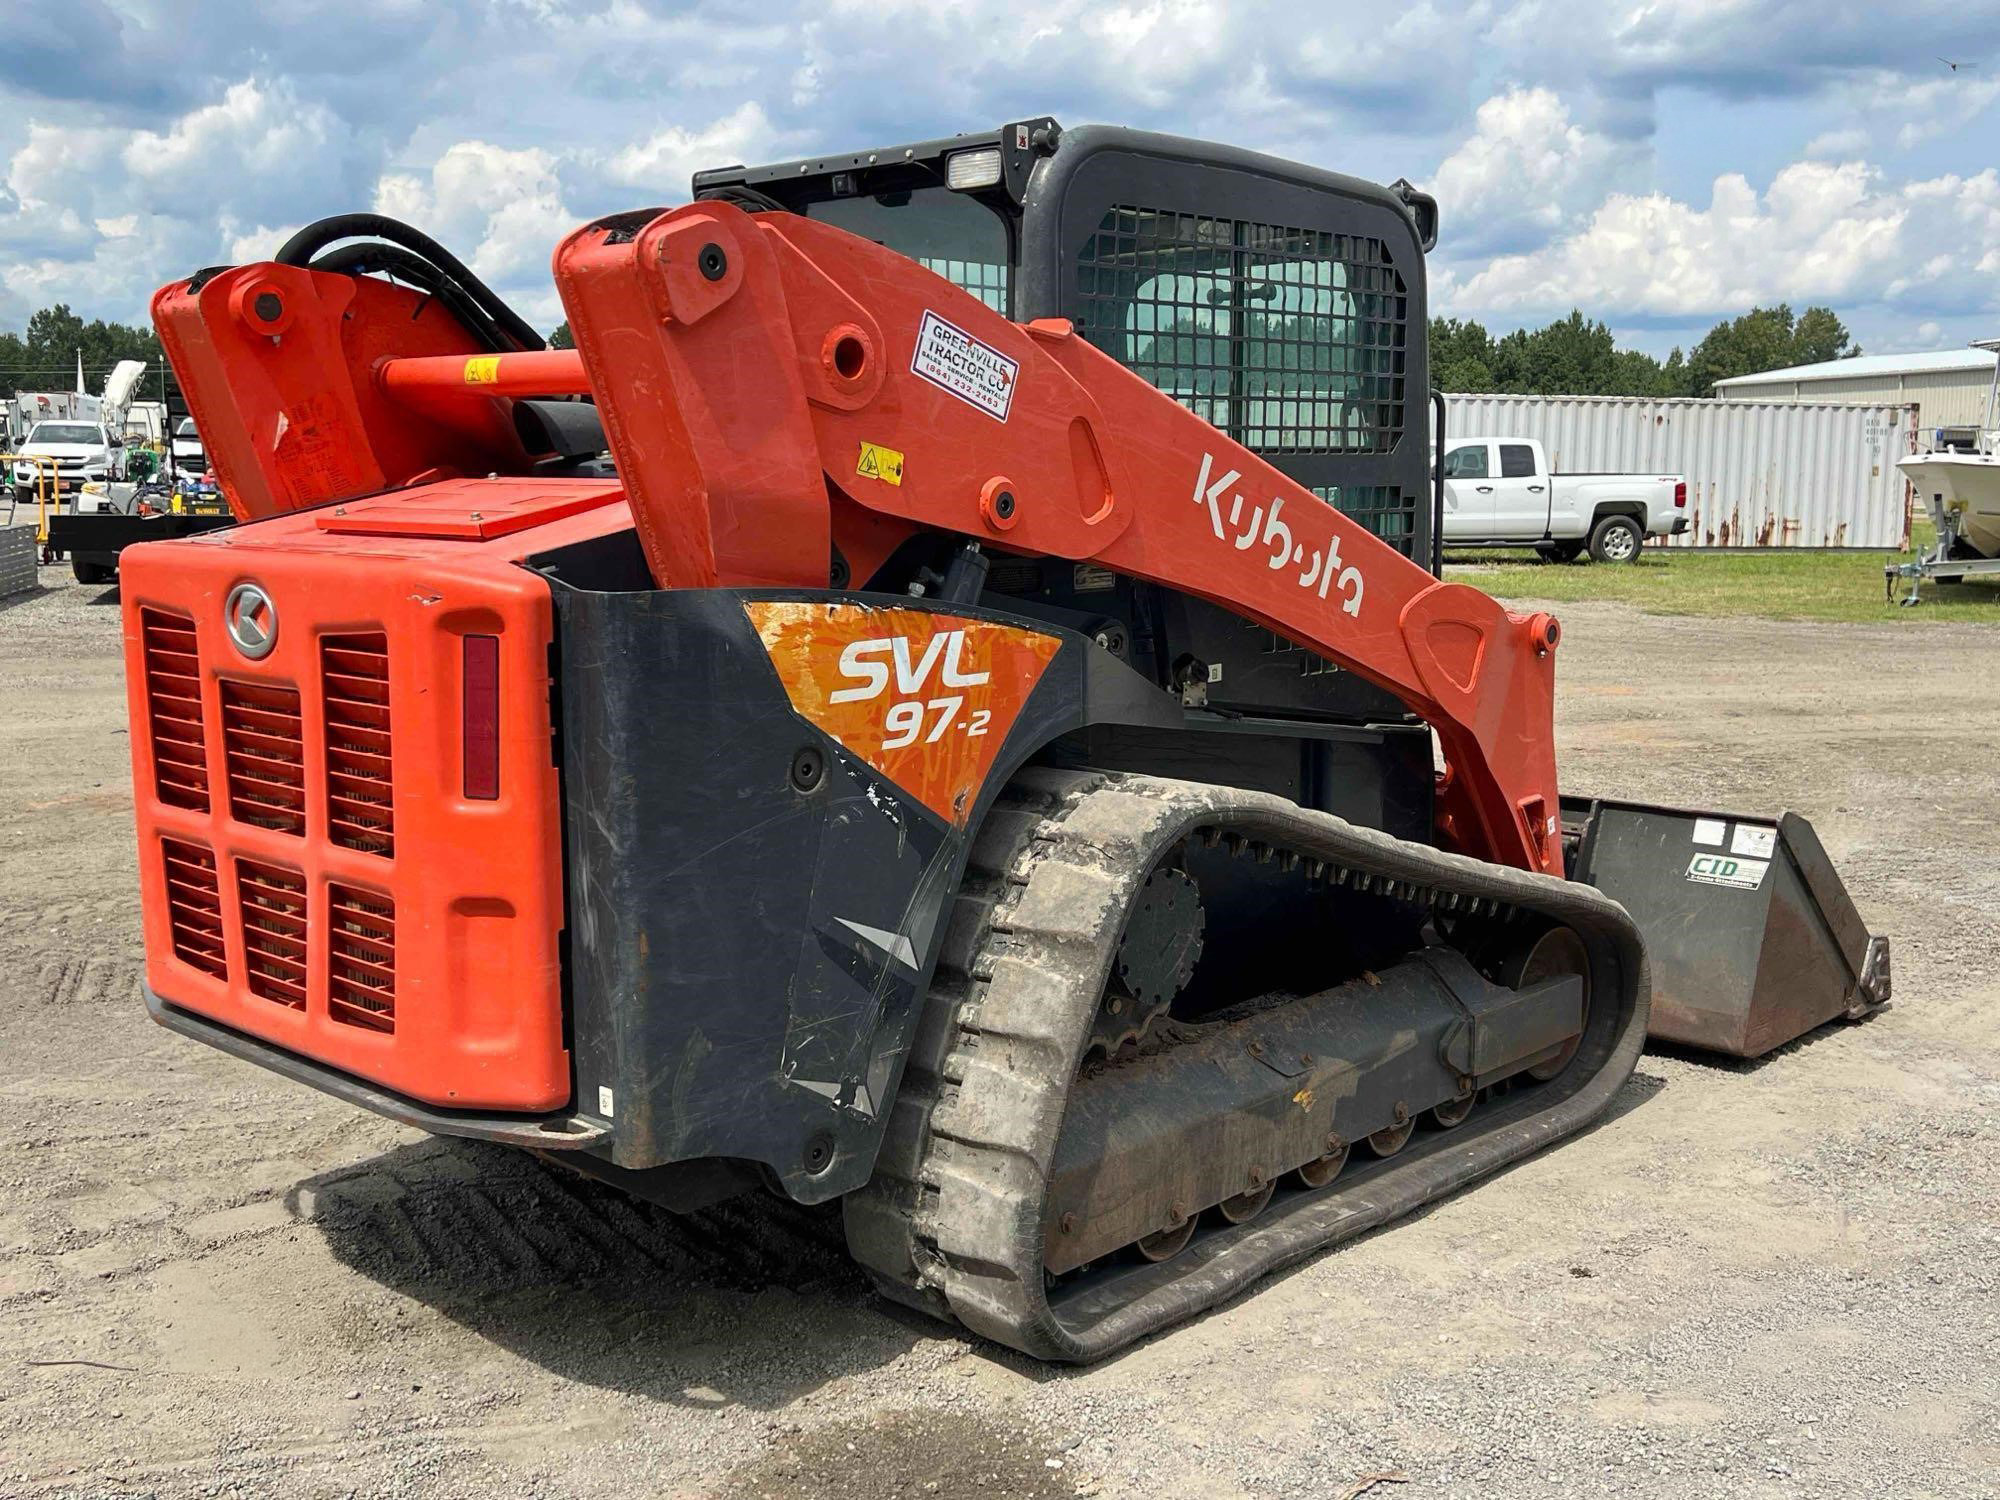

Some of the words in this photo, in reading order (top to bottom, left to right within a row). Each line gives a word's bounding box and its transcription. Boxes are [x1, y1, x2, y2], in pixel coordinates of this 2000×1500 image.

[921, 350, 942, 366] SALES
[947, 365, 975, 384] SERVICE
[978, 383, 1006, 402] RENTALS
[928, 340, 986, 381] TRACTOR
[933, 325, 1008, 376] GREENVILLE
[926, 363, 951, 382] (864)
[954, 379, 999, 408] 232-2463
[1192, 452, 1364, 618] Kubota
[830, 630, 990, 704] SVL
[882, 695, 991, 750] 97-2
[1693, 858, 1738, 877] CID
